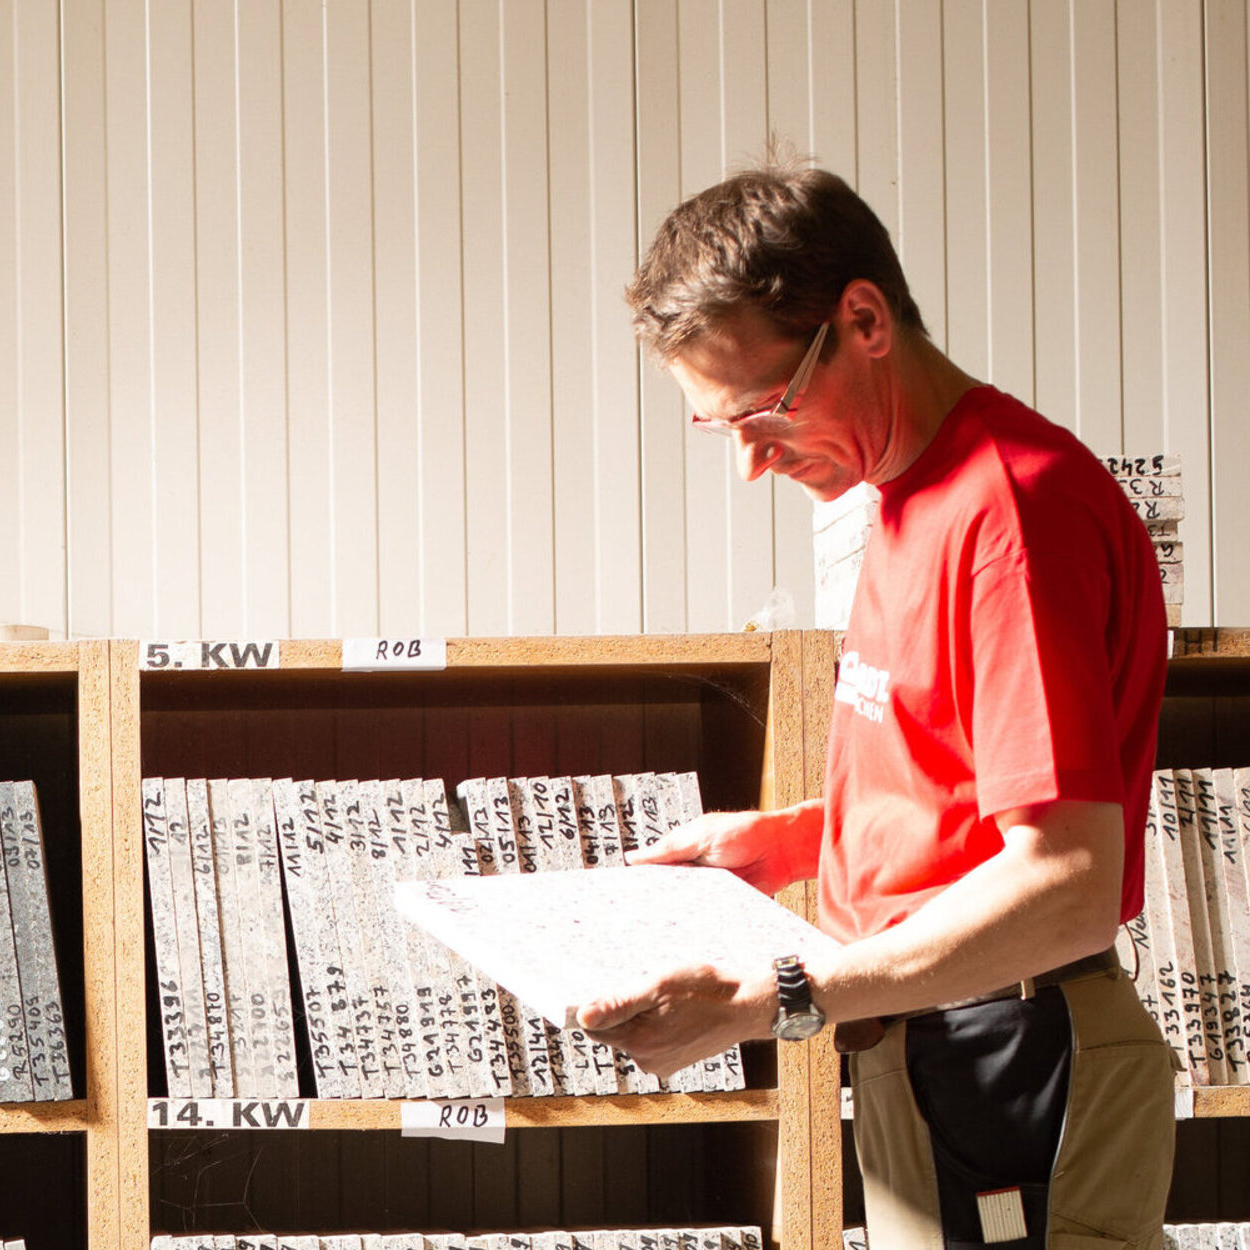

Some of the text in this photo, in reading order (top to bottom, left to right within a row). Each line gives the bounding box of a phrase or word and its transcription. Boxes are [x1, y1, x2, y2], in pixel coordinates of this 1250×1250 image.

[146, 642, 273, 667] 5. KW
[375, 640, 421, 661] ROB
[152, 1102, 305, 1127] 14. KW
[439, 1105, 488, 1128] ROB
